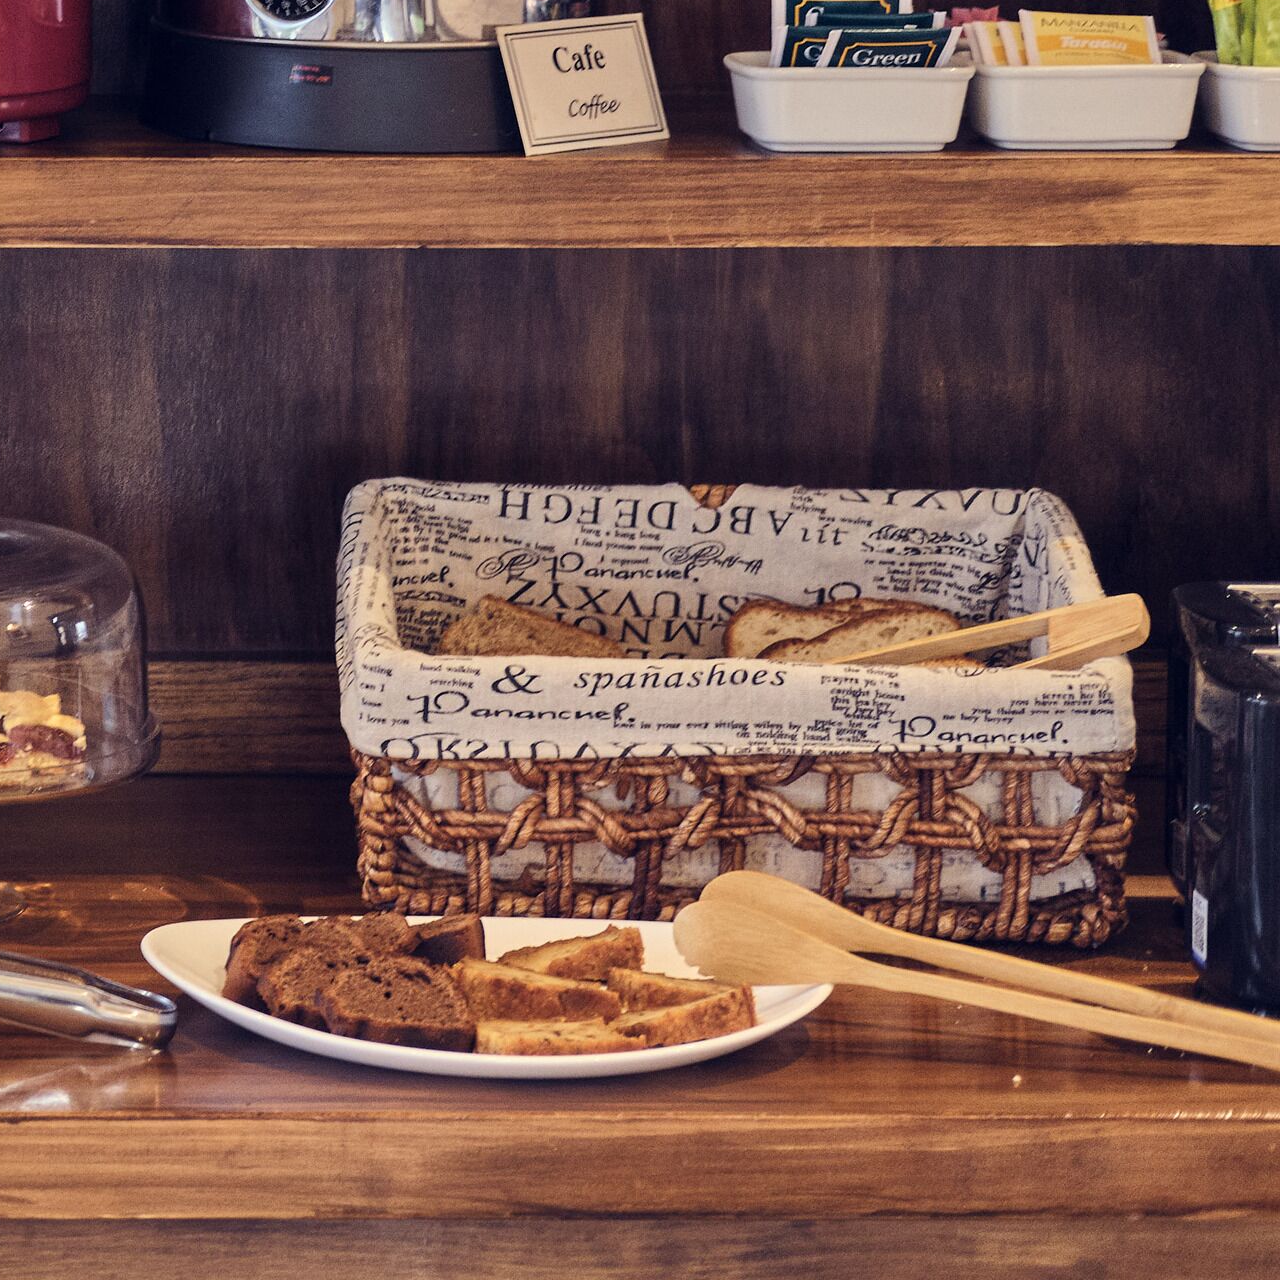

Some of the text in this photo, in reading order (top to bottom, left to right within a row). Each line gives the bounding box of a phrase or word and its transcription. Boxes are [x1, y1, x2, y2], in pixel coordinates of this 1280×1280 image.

[552, 43, 607, 73] Cafe
[851, 48, 922, 67] Green
[568, 93, 621, 120] Coffee
[490, 662, 547, 696] &
